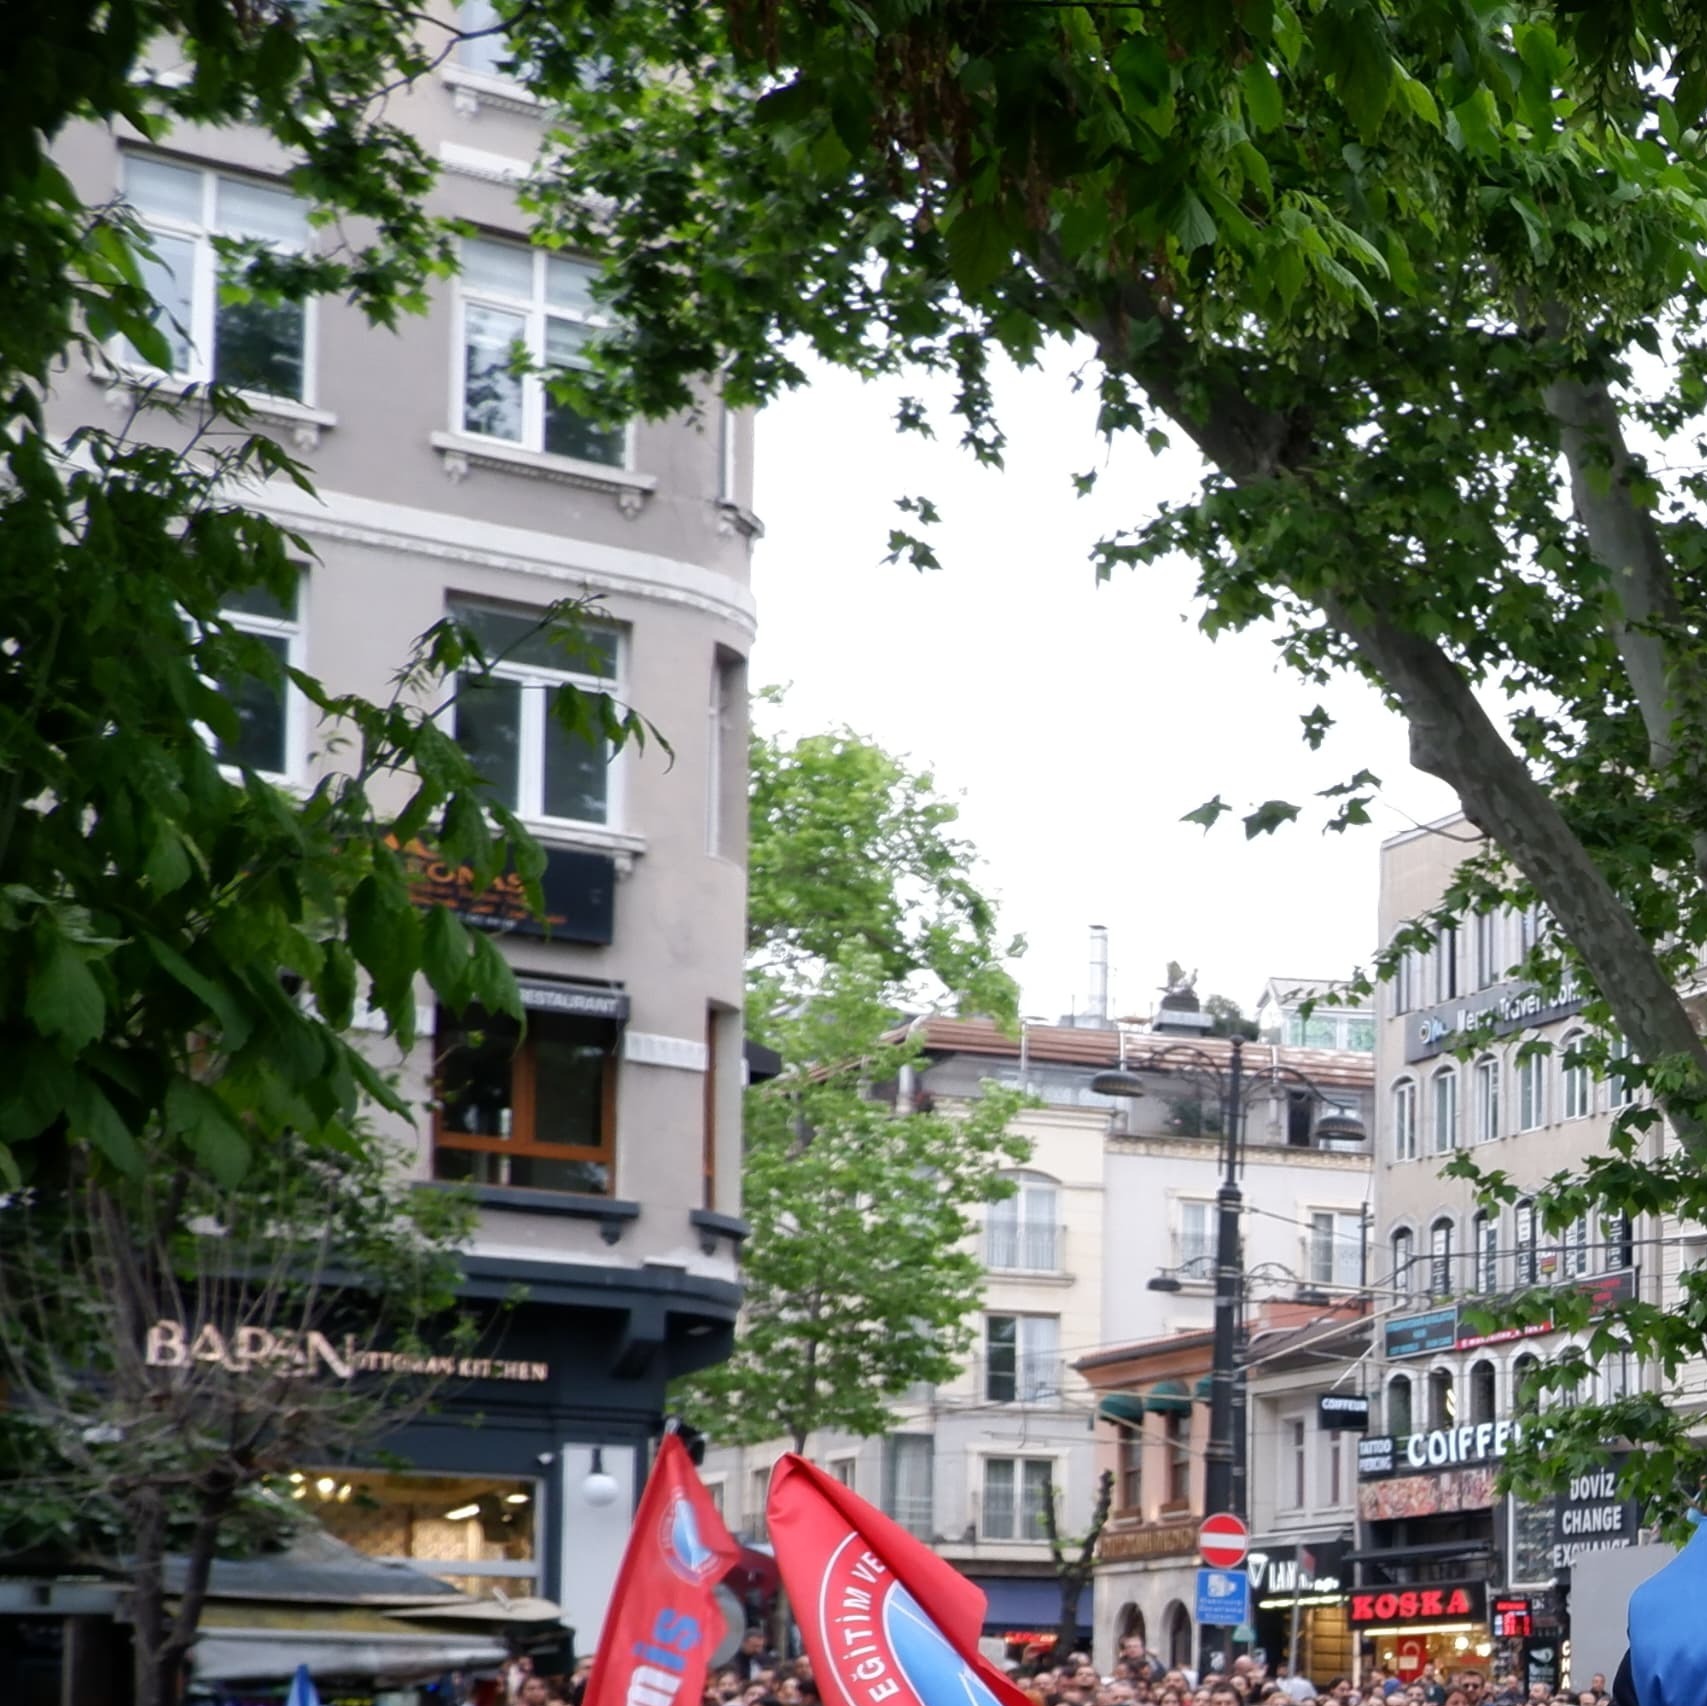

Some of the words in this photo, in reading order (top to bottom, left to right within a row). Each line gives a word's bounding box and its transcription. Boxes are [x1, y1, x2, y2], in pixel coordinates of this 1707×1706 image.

[1562, 1505, 1622, 1534] CHANGE
[851, 1551, 887, 1585] VE
[1352, 1588, 1470, 1621] KOSKA
[834, 1586, 900, 1703] EĞİTİM
